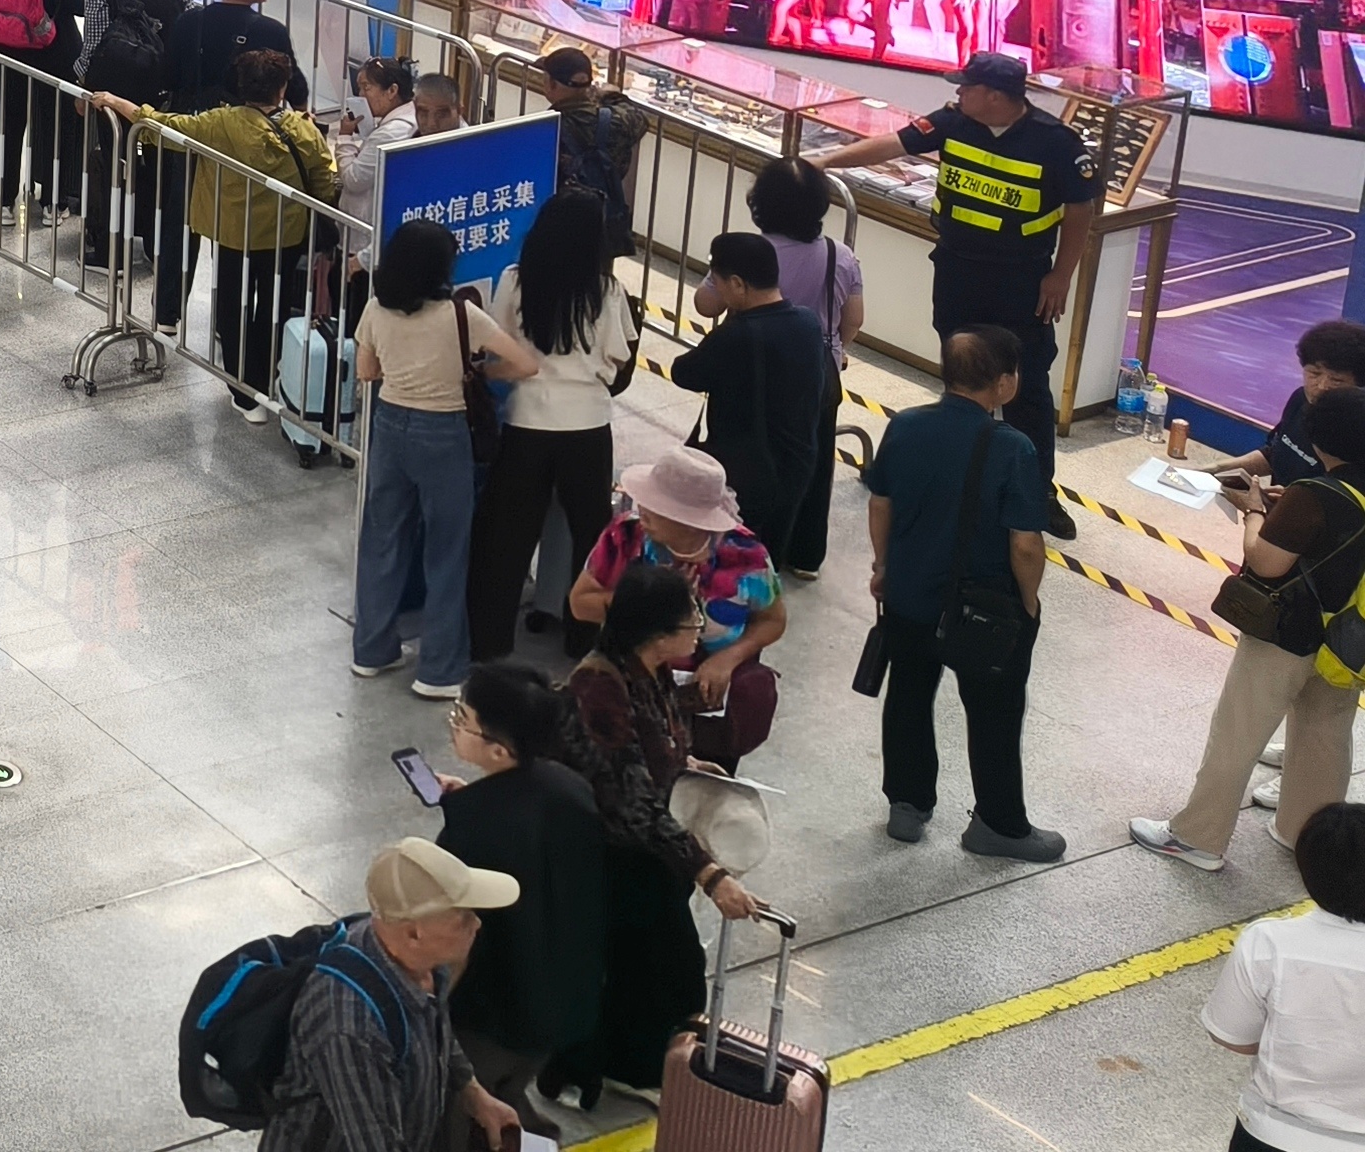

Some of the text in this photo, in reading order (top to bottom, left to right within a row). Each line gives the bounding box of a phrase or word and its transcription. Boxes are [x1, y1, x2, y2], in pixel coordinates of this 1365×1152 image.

[402, 180, 535, 225] 邮轮信息采集
[945, 167, 1022, 208] 执 ZHI QIN 勤
